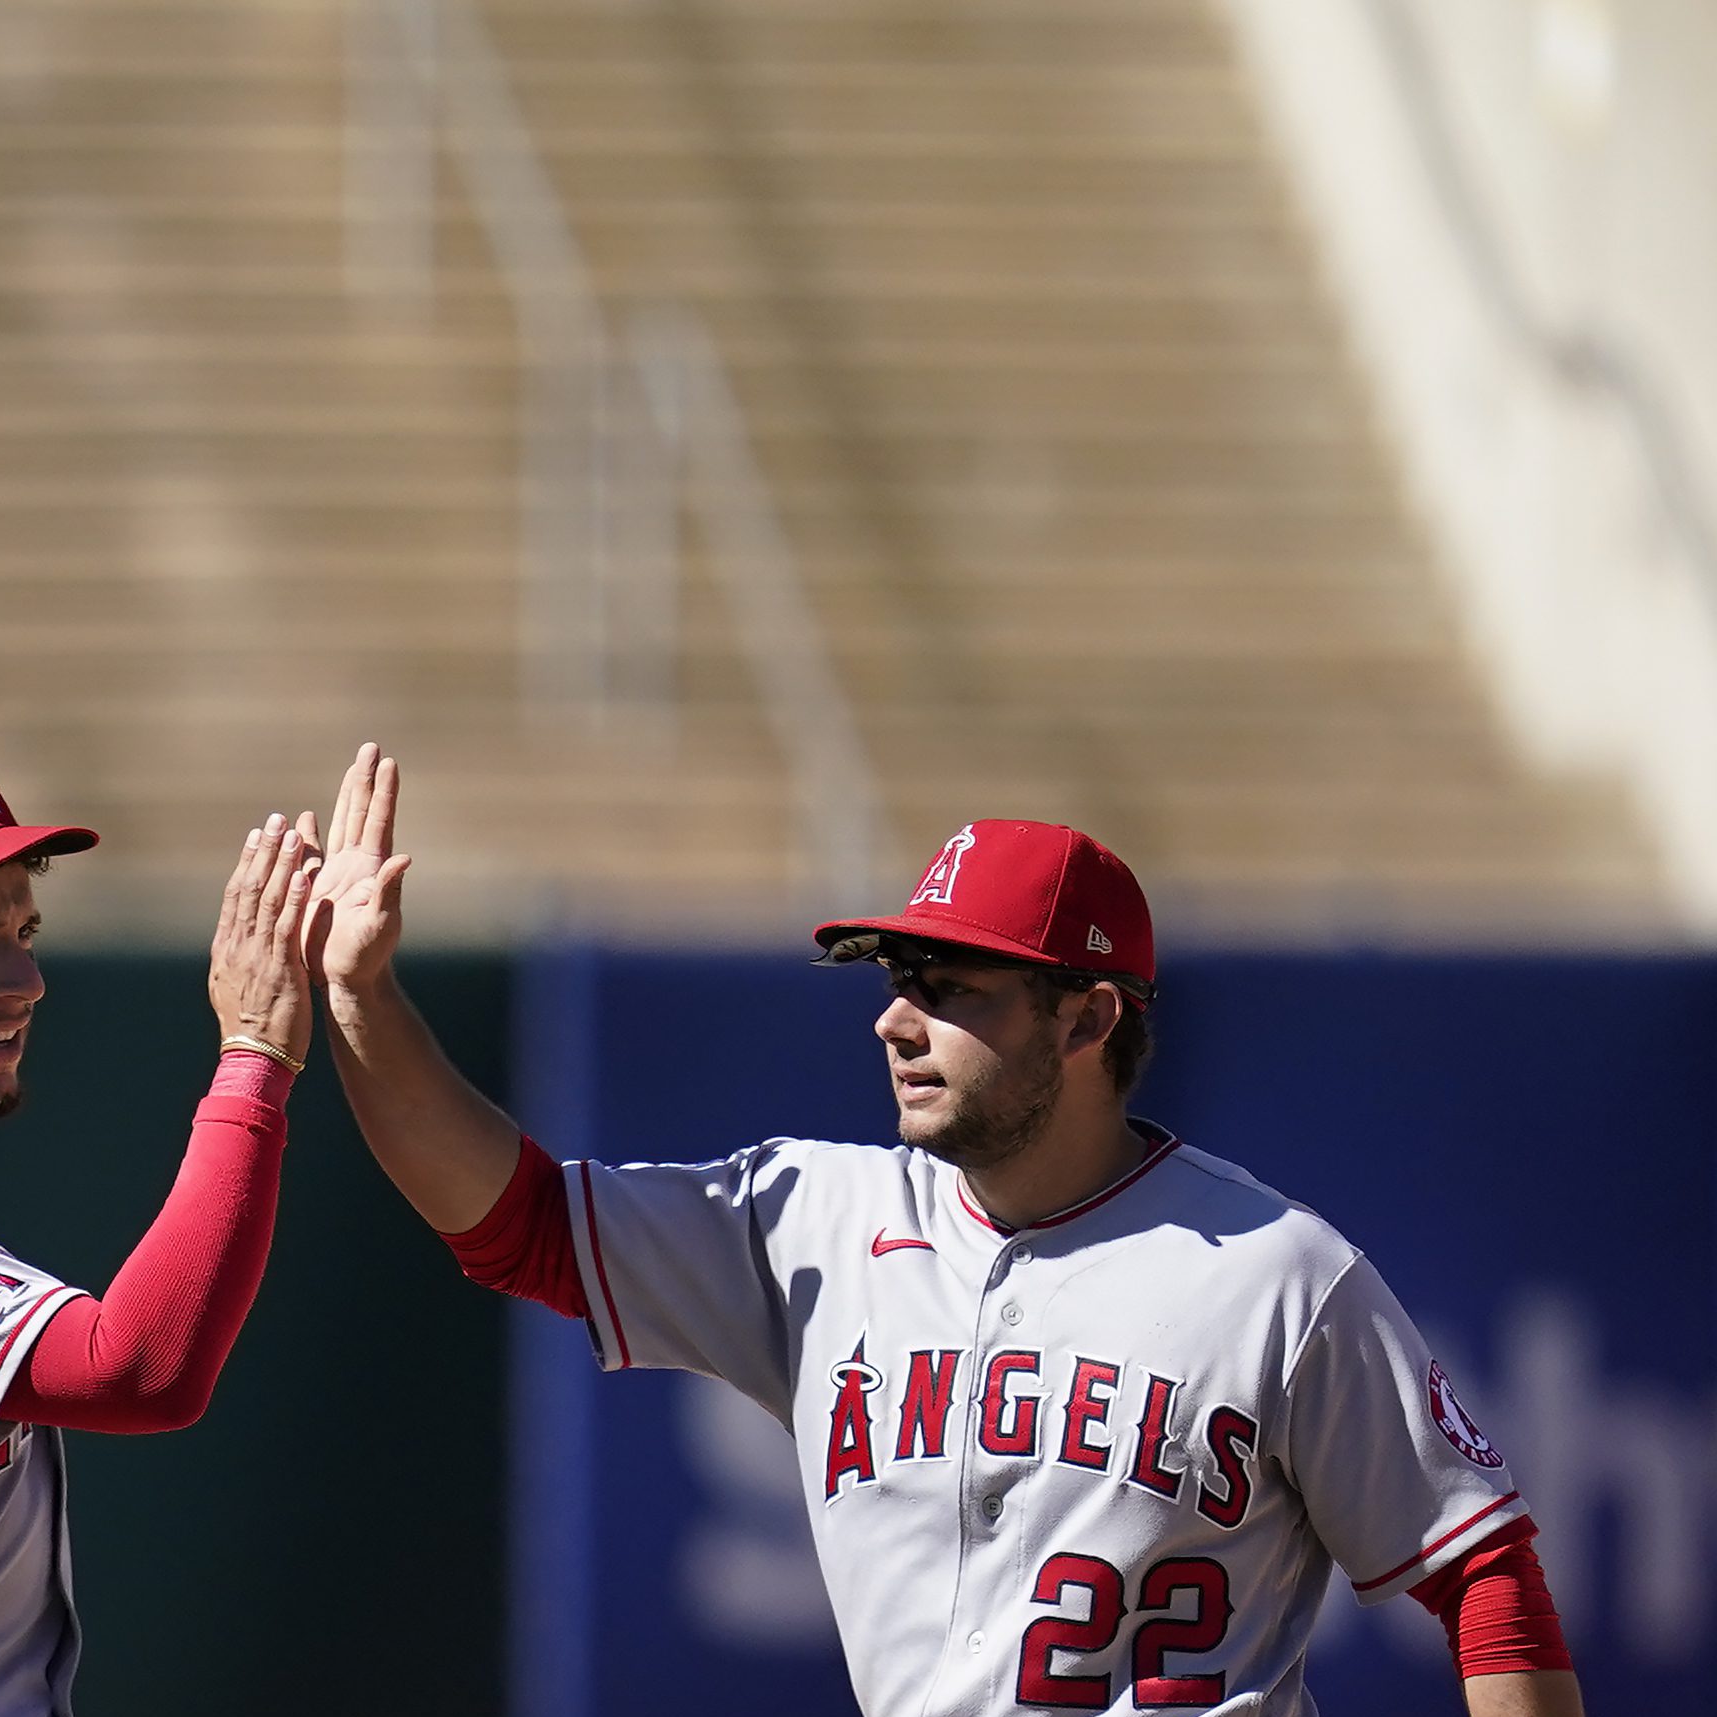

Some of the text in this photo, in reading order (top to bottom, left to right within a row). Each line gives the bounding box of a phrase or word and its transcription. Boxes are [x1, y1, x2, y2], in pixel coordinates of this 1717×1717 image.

[909, 824, 977, 906] A
[825, 1329, 1260, 1531] ANGELS
[1016, 1552, 1235, 1709] 22
